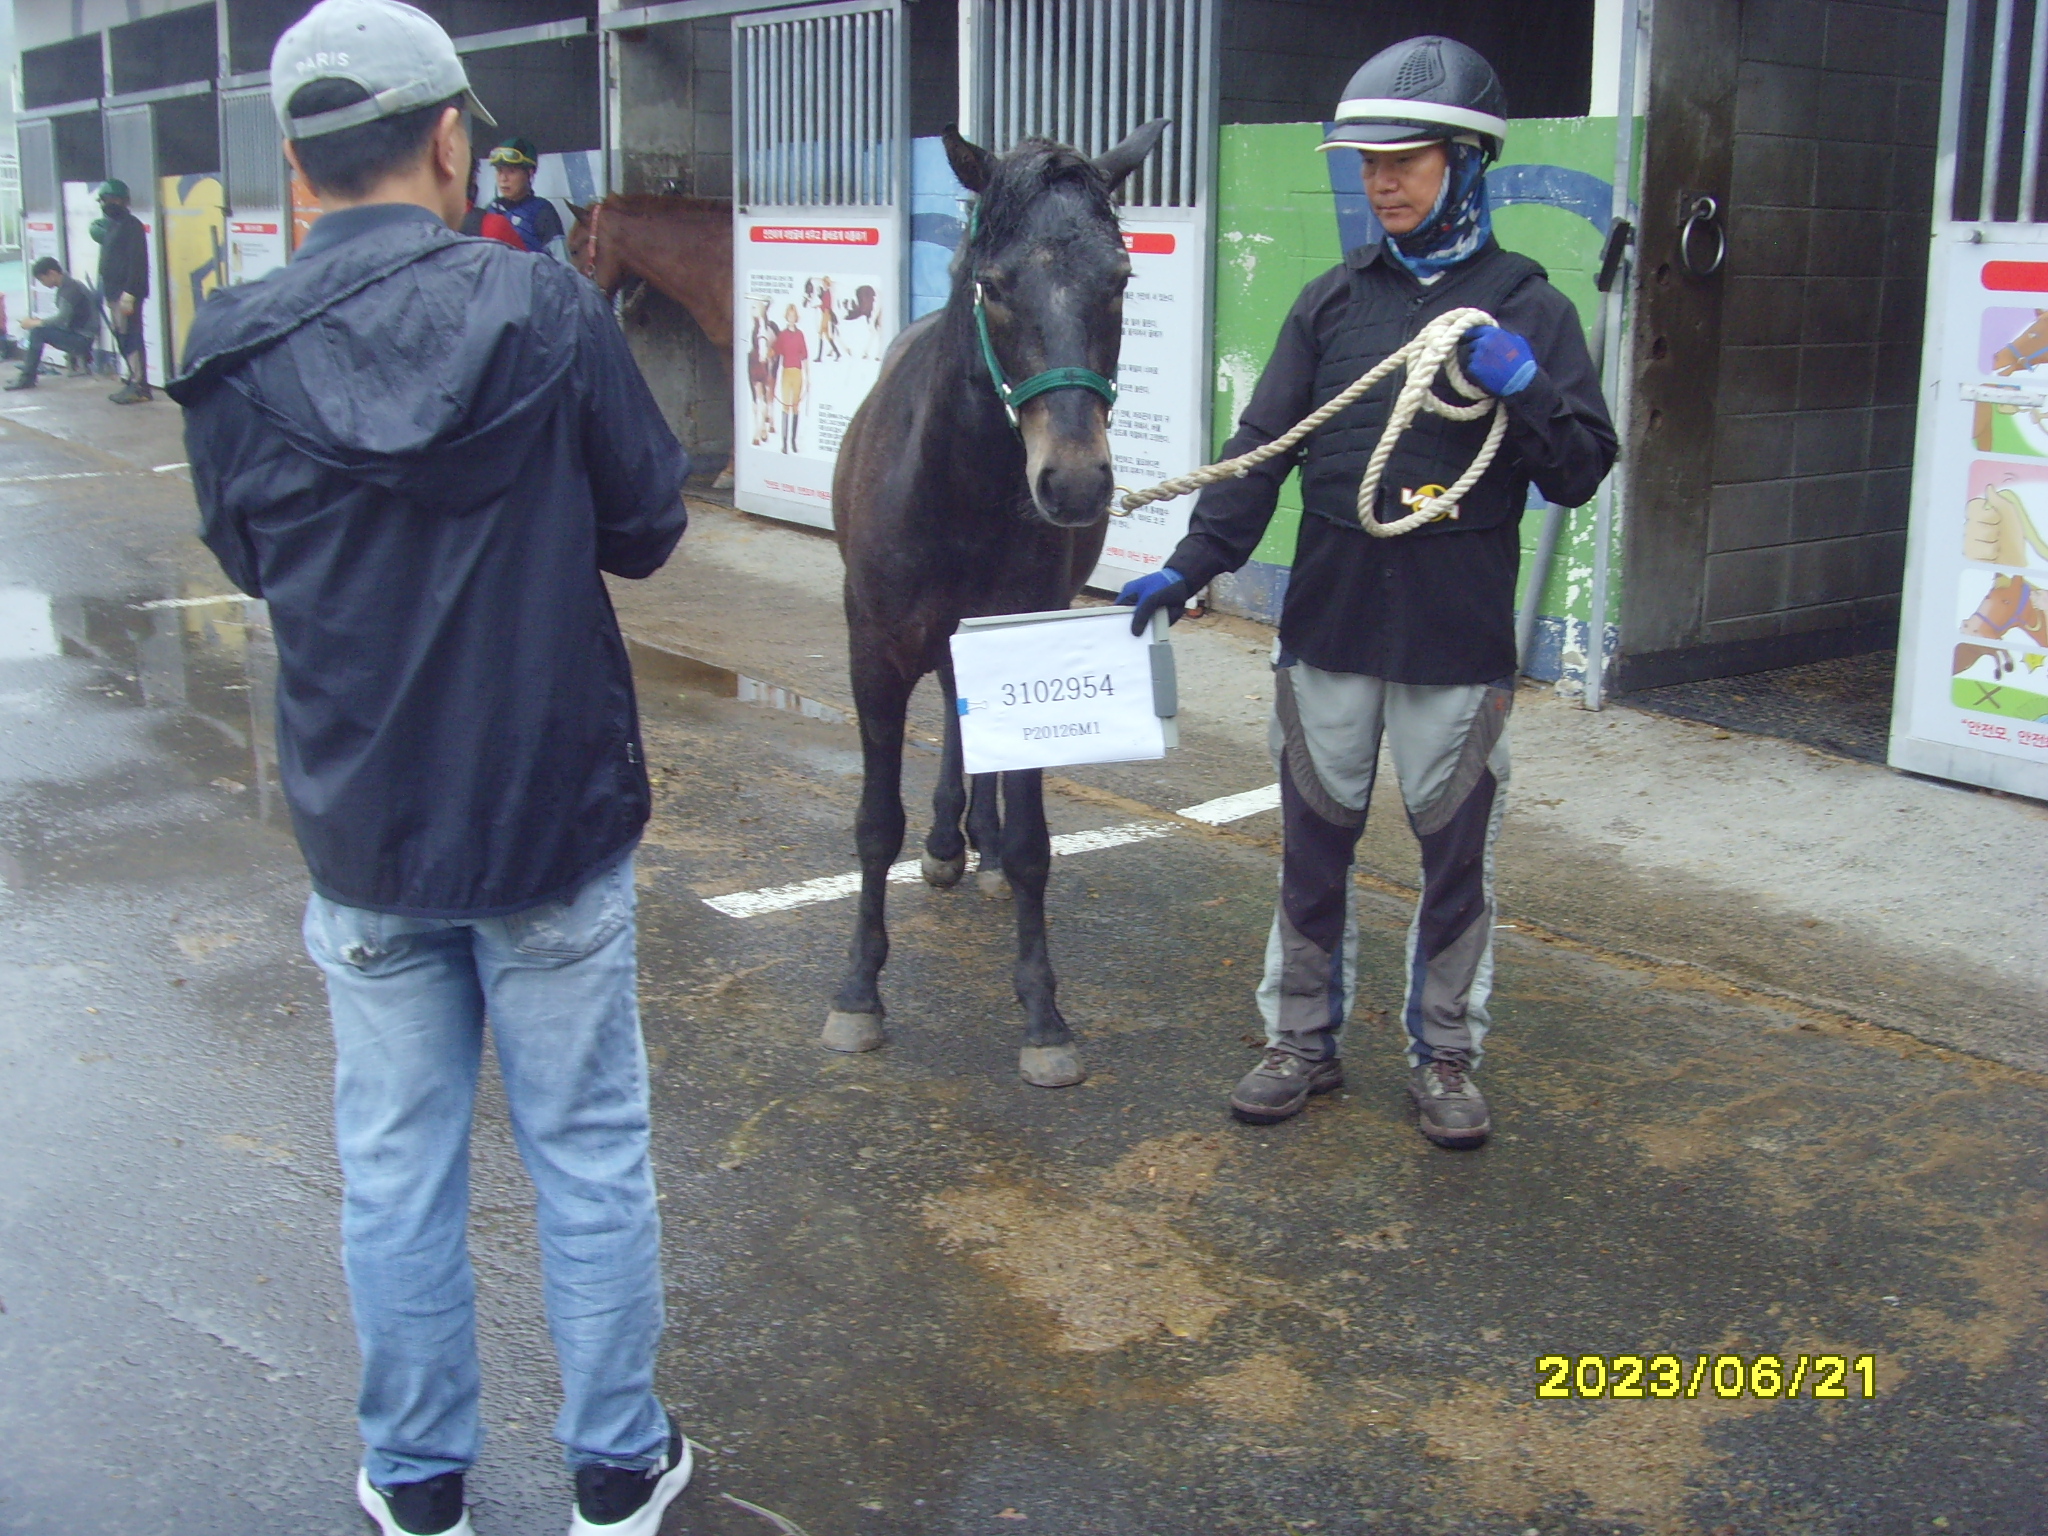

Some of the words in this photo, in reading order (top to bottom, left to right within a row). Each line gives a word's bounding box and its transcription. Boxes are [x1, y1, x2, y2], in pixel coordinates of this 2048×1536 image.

[295, 51, 350, 76] PARIS
[1001, 674, 1116, 706] 3102954
[1022, 721, 1101, 741] P20126M1
